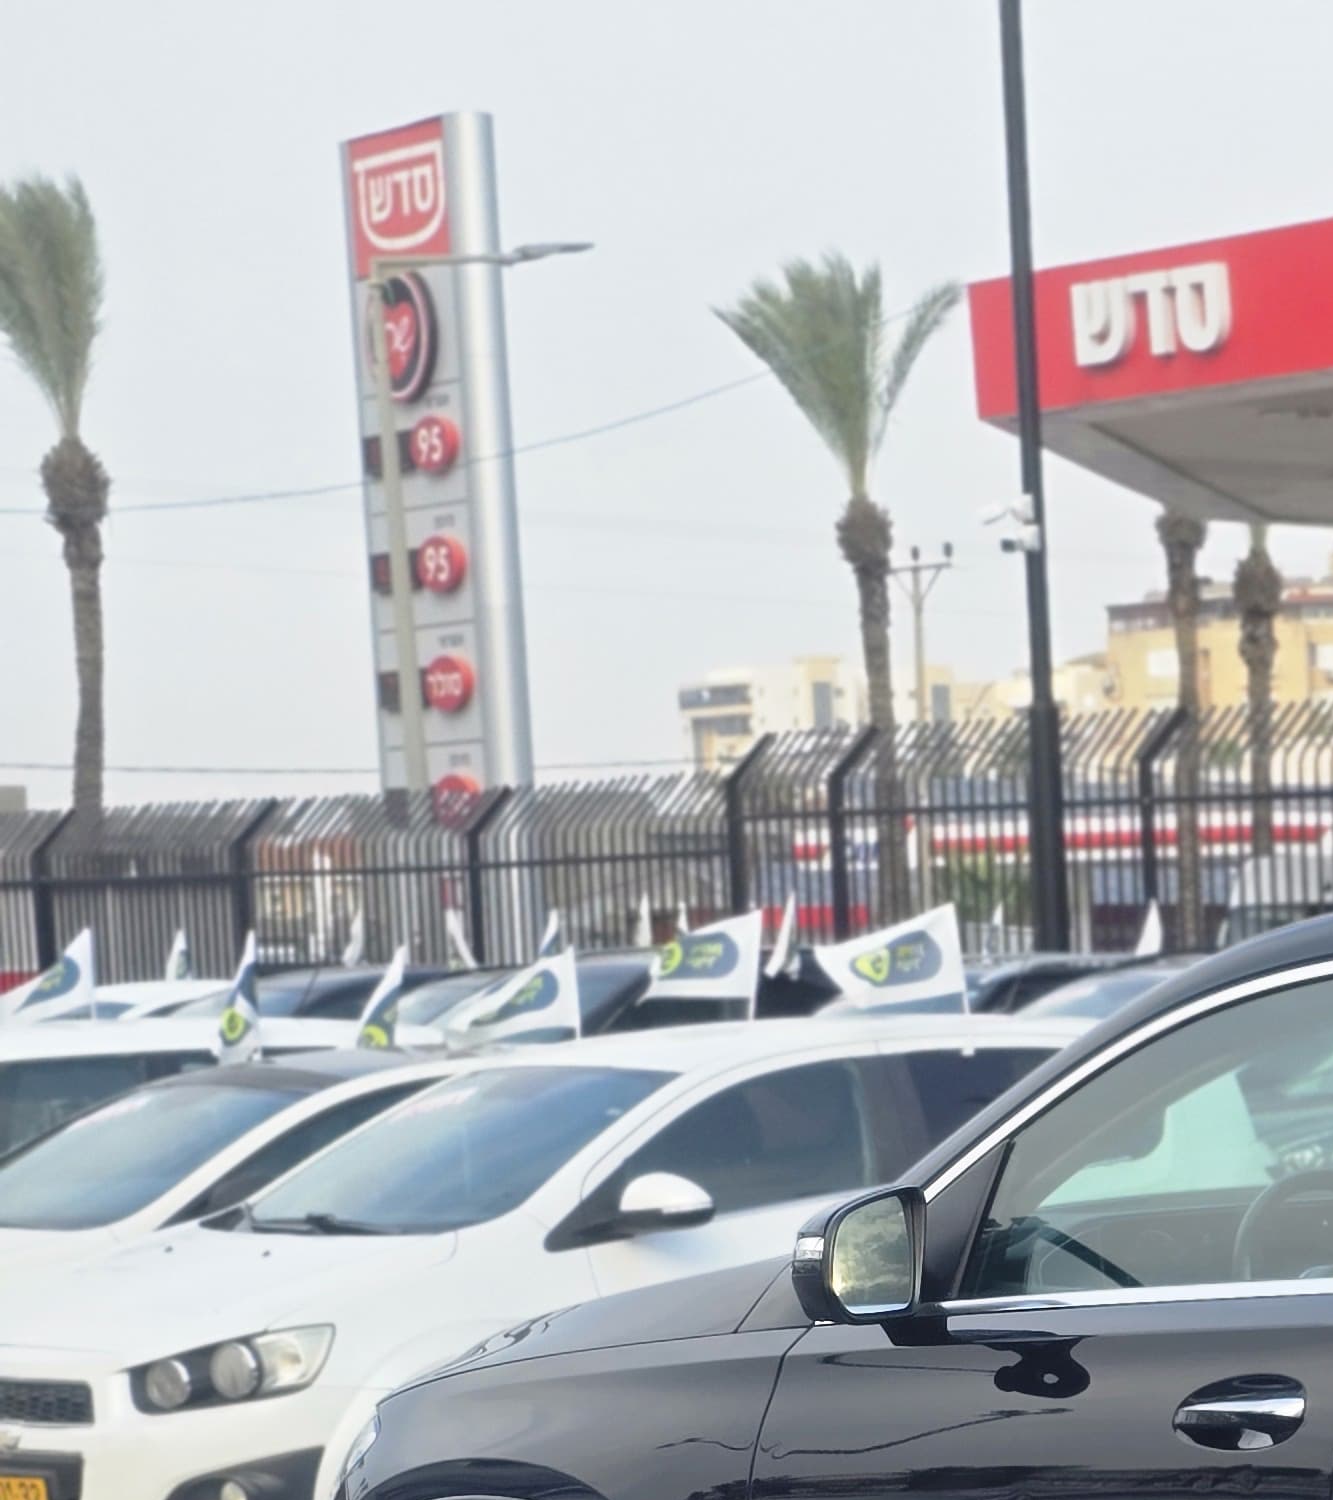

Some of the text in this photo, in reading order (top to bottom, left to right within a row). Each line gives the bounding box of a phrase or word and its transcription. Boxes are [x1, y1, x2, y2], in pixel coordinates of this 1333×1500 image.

[1069, 261, 1232, 368] סדש
[417, 426, 444, 463] 95
[424, 546, 450, 583] 95
